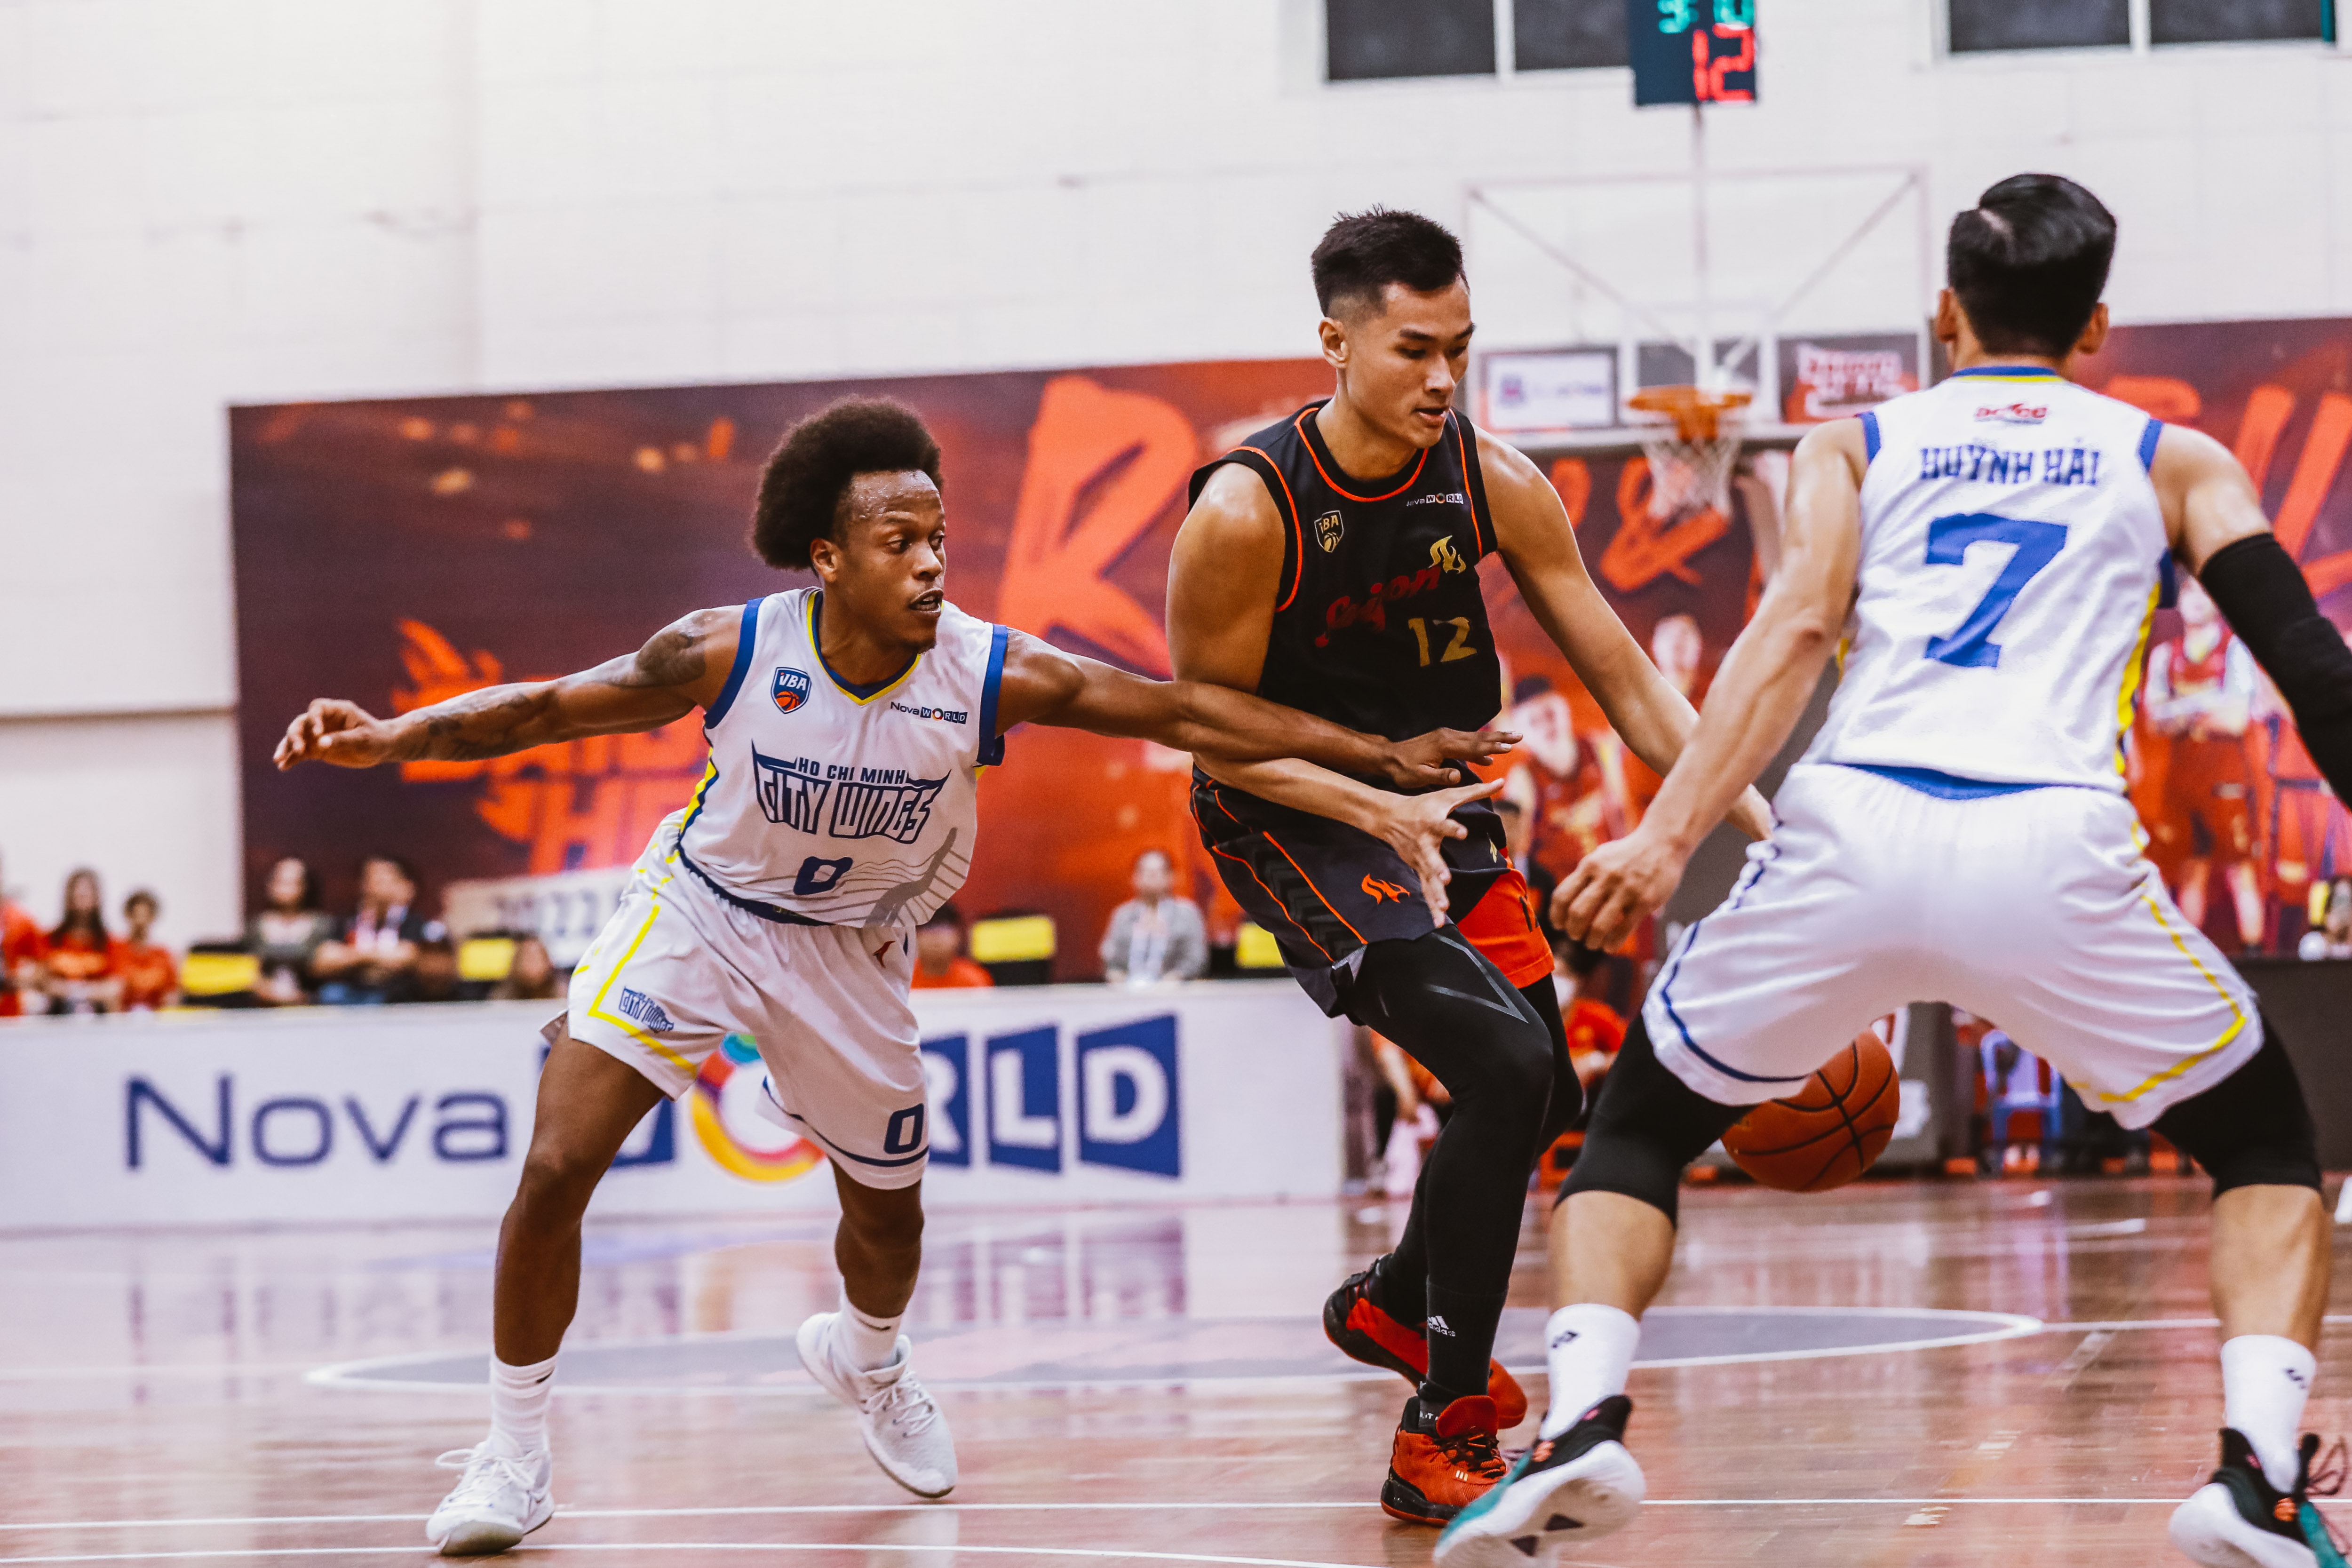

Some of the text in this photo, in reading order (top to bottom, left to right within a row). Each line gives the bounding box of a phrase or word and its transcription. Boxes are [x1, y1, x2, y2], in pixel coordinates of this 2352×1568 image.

[1692, 24, 1755, 102] 12
[1923, 512, 2068, 669] 7
[1407, 616, 1478, 668] 12
[779, 672, 808, 692] VBA
[798, 756, 906, 785] HO CHI MINH
[753, 756, 942, 844] CITY WINGS
[793, 856, 853, 896] 0
[619, 987, 648, 1020] CITY
[883, 1103, 924, 1154] 0
